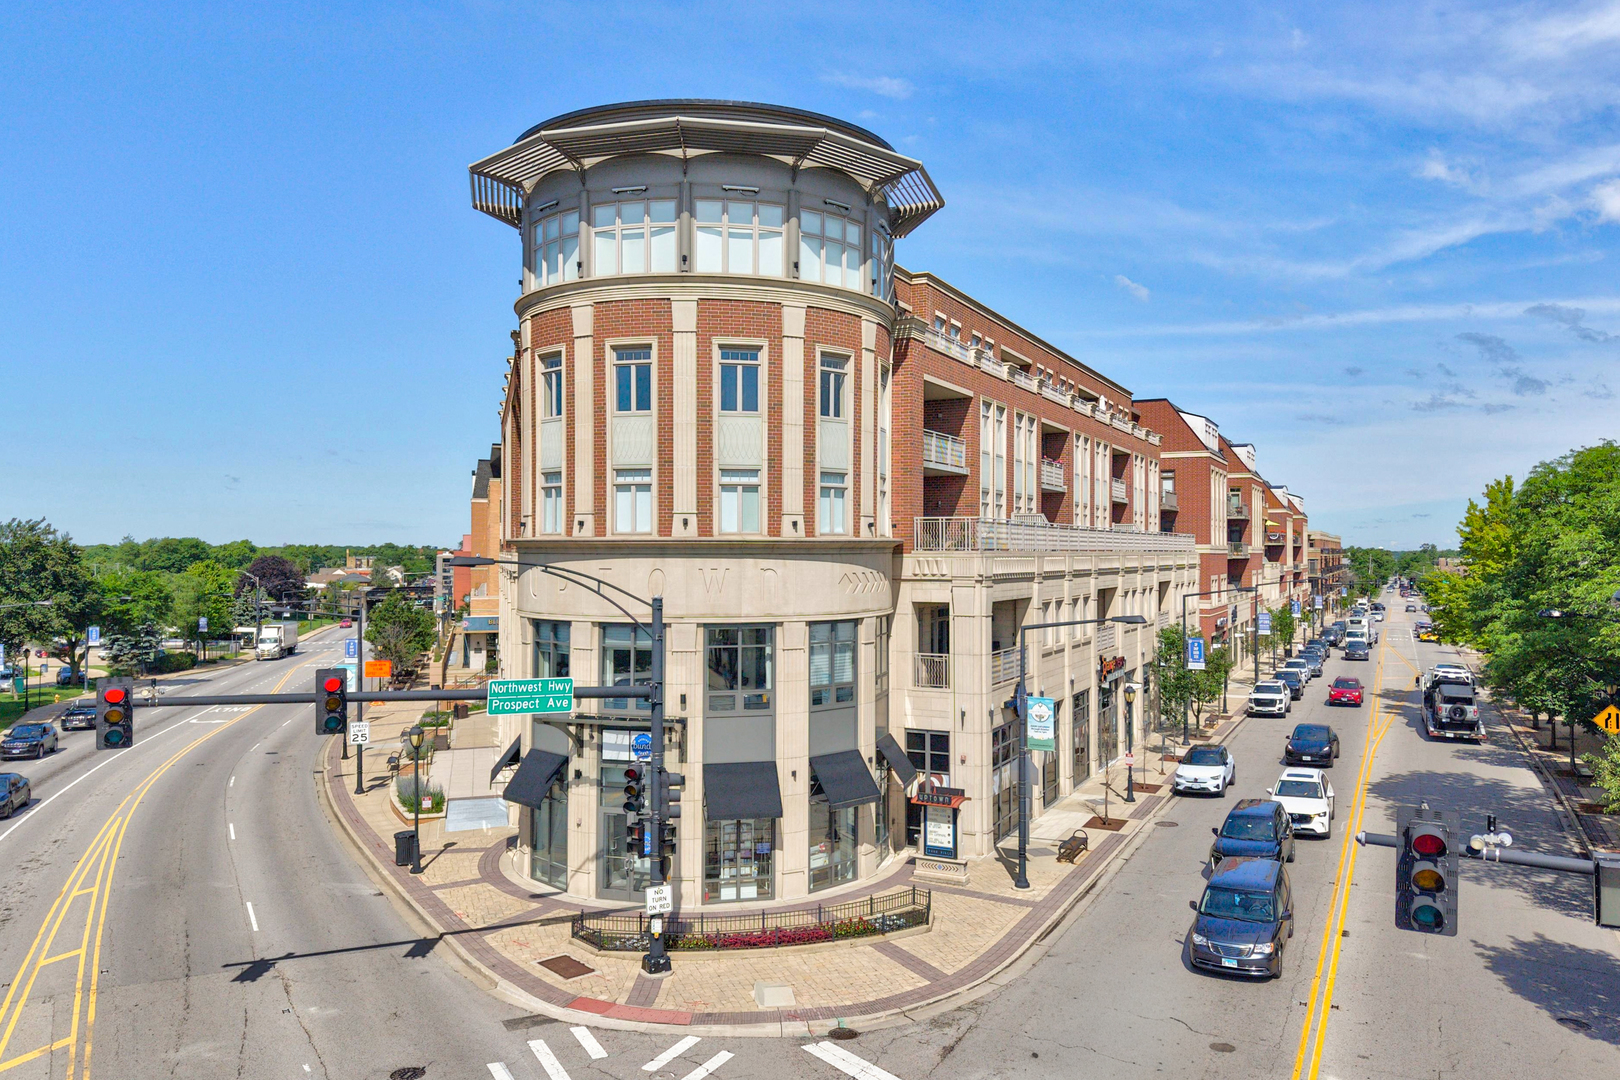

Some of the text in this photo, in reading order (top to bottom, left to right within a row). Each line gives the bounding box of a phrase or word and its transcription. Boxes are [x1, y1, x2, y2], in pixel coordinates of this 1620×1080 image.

[491, 680, 571, 694] Northwest Hwy
[492, 697, 569, 712] Prospect Ave
[352, 733, 368, 742] 25
[651, 895, 667, 904] TURN
